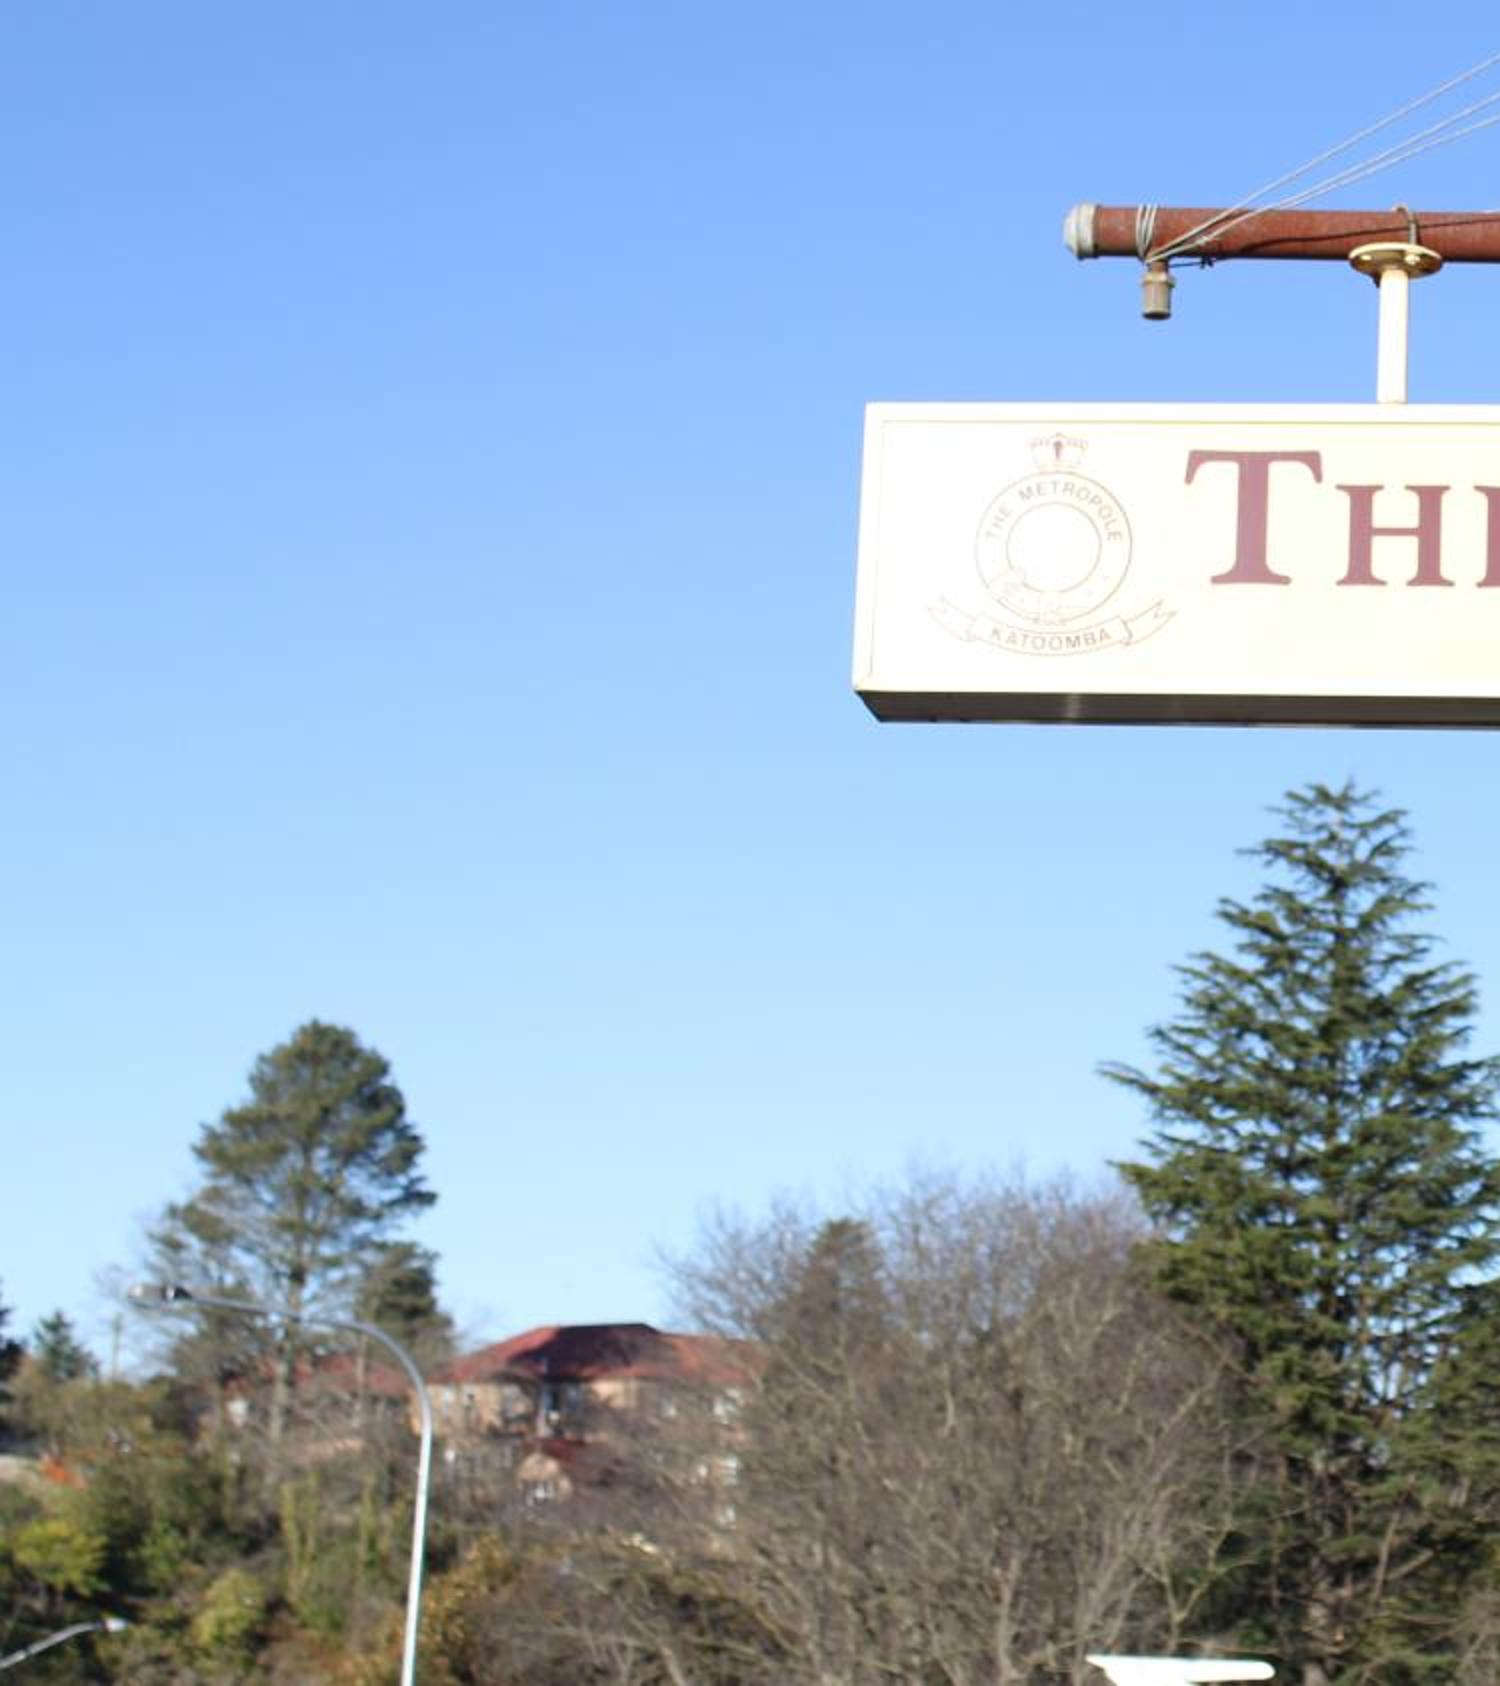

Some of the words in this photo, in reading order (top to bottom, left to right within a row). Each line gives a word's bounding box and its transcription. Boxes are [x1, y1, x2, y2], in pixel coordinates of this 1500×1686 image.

[985, 502, 1014, 541] THE
[1018, 480, 1123, 543] METROPOLE
[991, 627, 1112, 651] KATOOMBA
